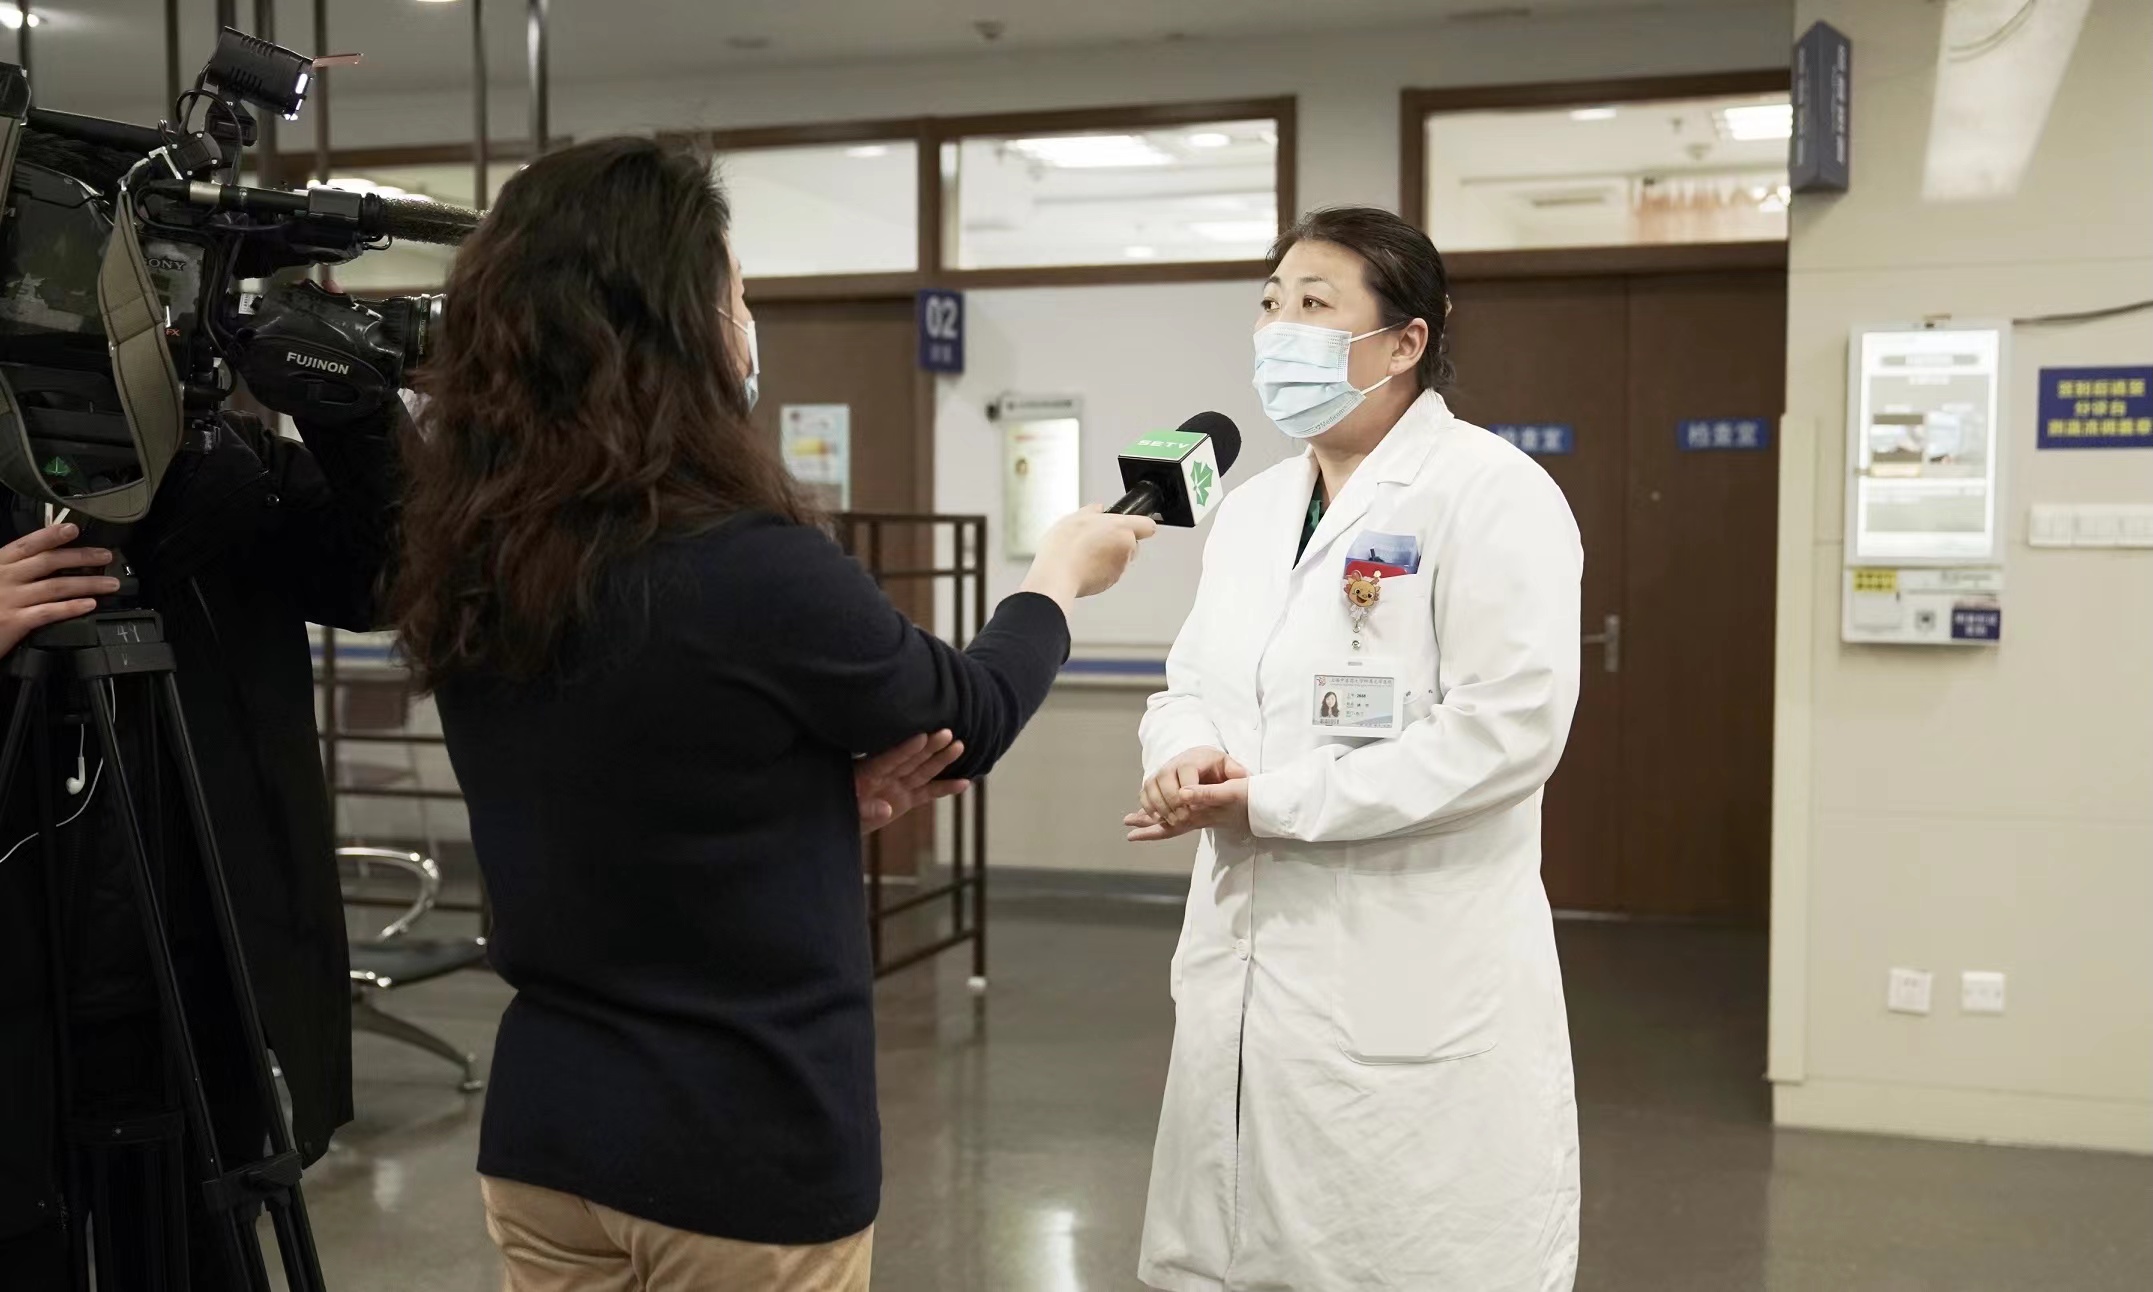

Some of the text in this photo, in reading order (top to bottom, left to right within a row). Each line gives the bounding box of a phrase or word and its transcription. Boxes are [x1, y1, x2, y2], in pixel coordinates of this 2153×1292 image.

[925, 294, 959, 339] 02
[286, 351, 349, 375] FUJINON
[1137, 439, 1191, 449] SETV
